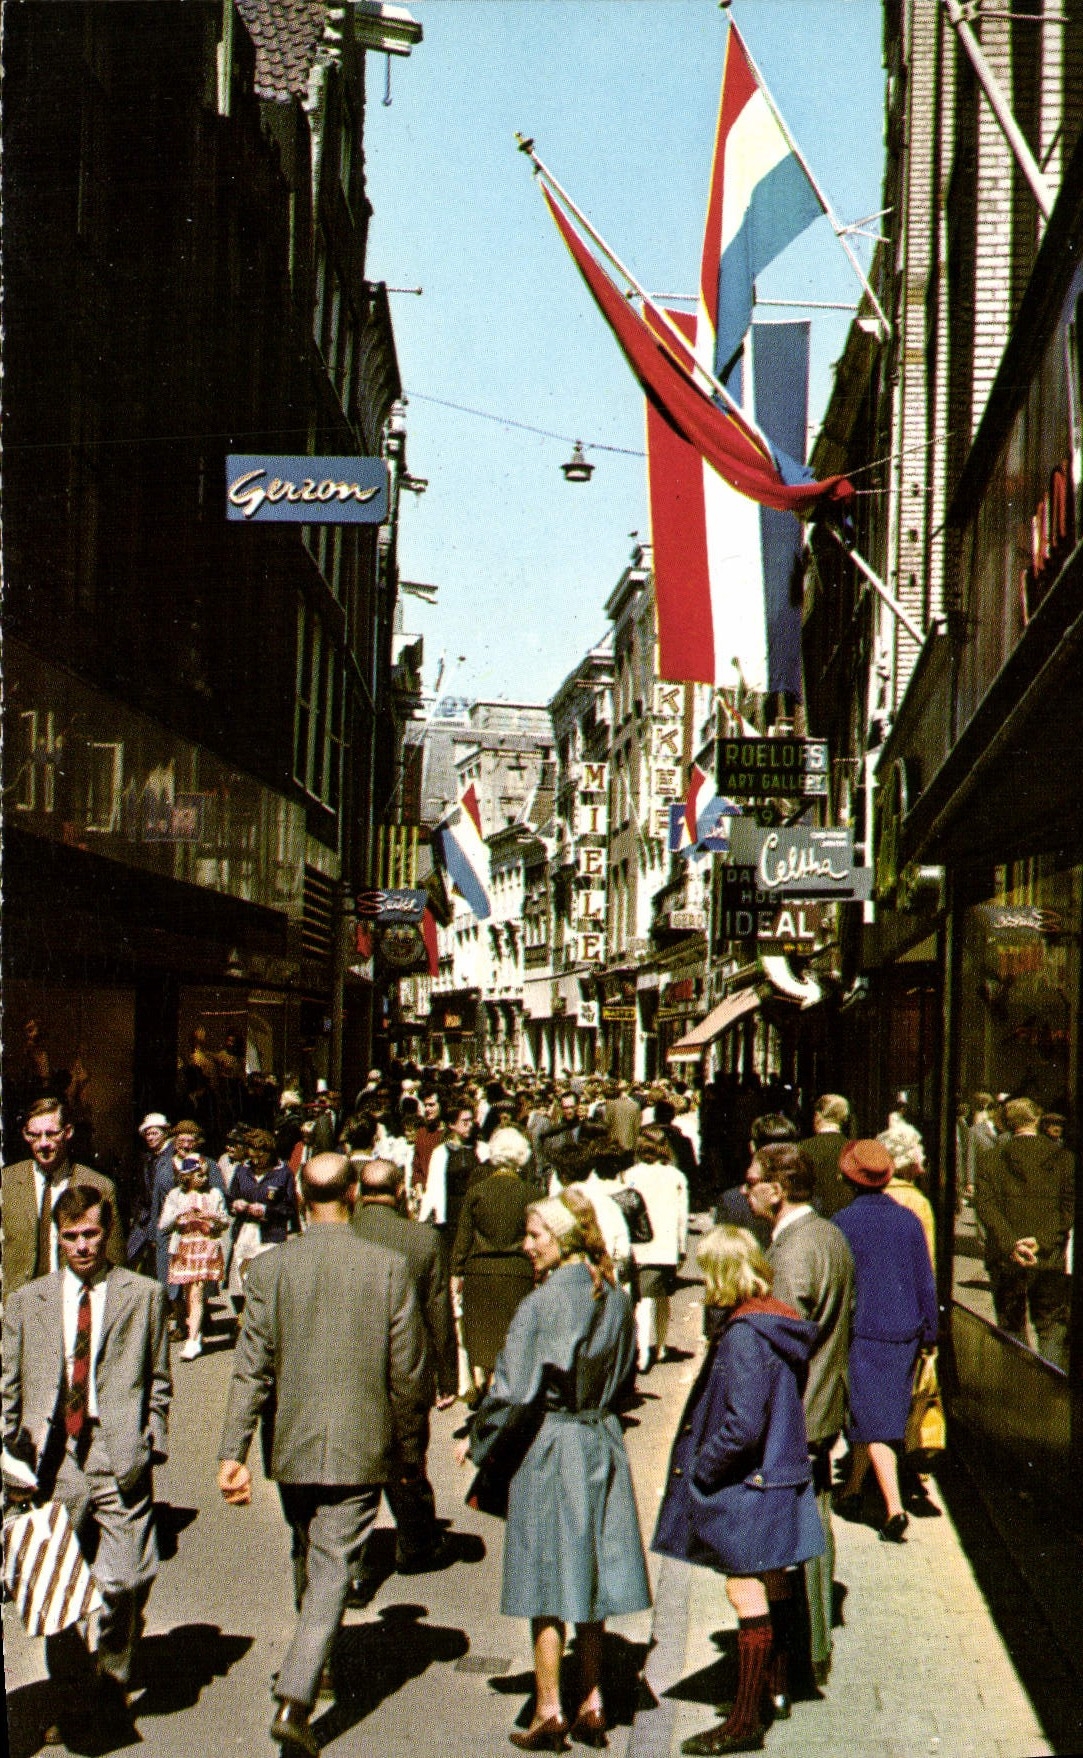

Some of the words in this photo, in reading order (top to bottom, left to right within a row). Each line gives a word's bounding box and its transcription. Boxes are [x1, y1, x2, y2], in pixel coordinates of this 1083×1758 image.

[228, 469, 380, 518] Gerzon
[725, 744, 823, 768] ROELOFS
[727, 772, 755, 790] ART
[761, 772, 826, 790] GALLERY
[580, 764, 606, 961] MIELE
[725, 910, 815, 938] IDEAL
